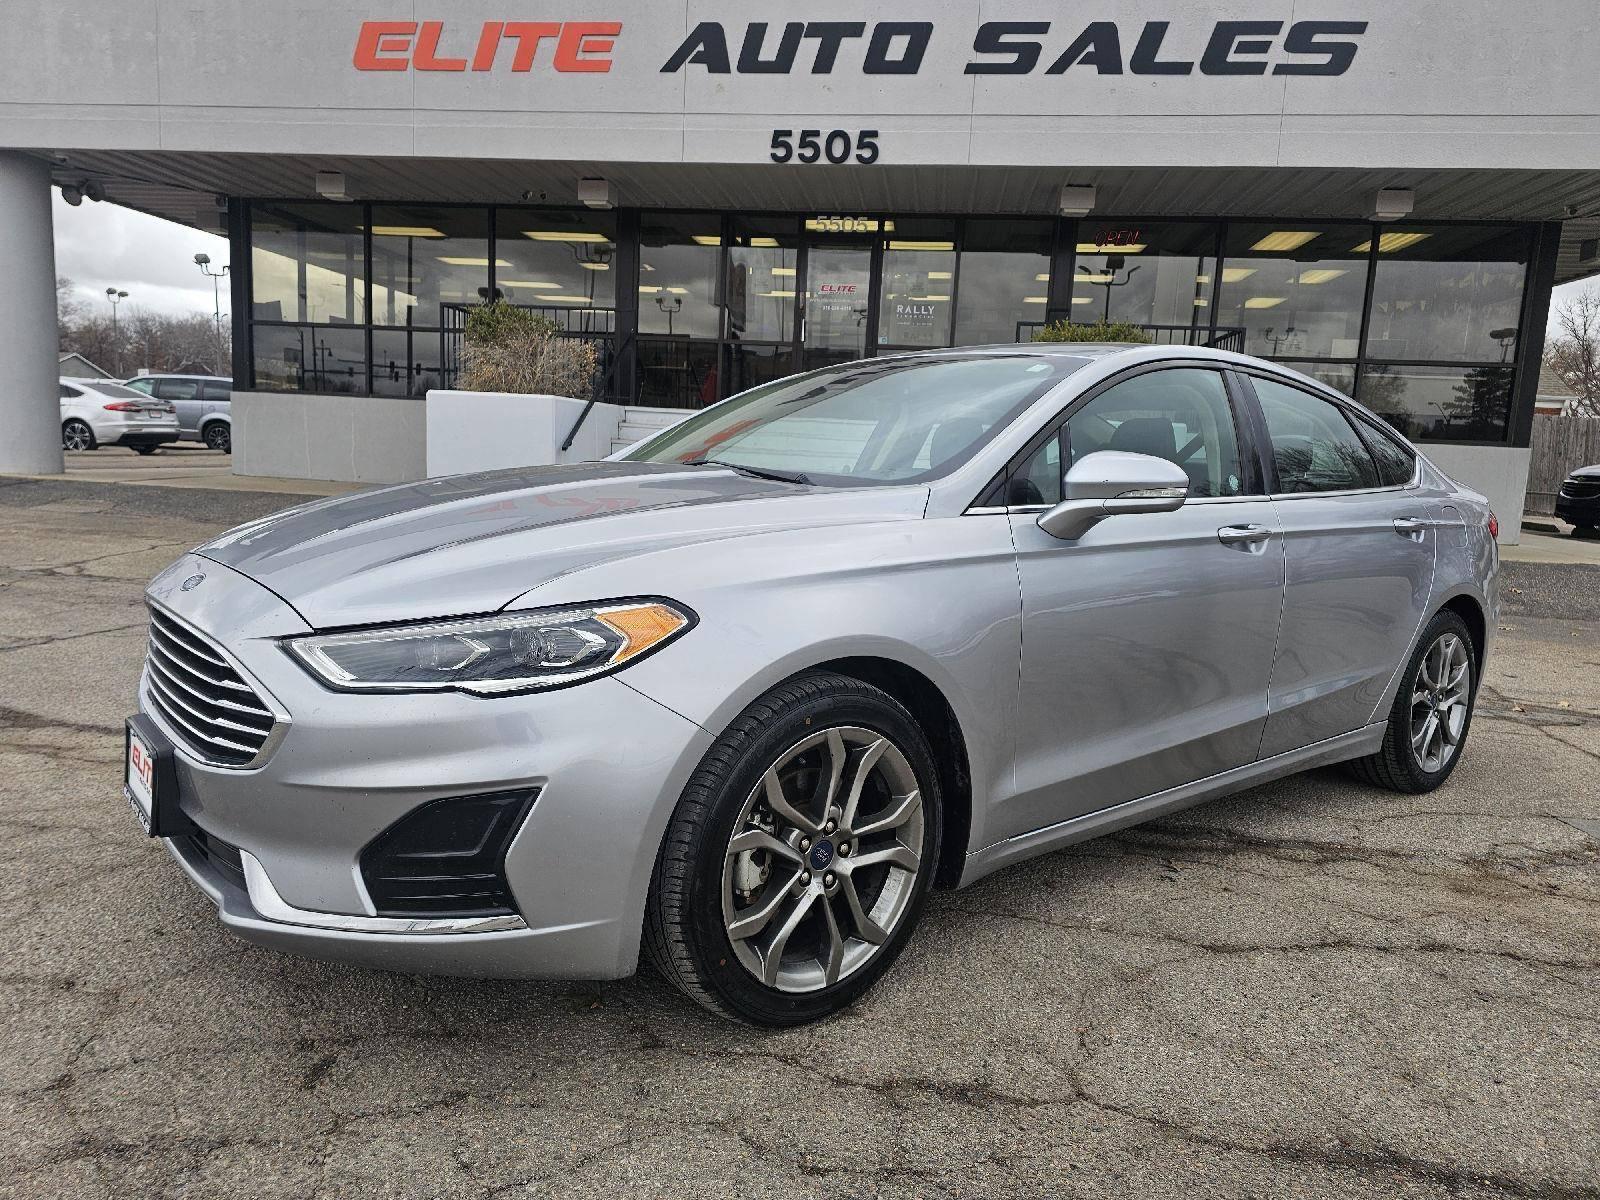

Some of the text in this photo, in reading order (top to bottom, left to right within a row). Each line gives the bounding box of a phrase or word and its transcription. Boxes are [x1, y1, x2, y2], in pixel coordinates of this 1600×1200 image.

[353, 20, 1369, 76] ELITE AUTO SALES
[770, 129, 879, 165] 5505
[816, 215, 868, 232] 5505
[1096, 229, 1141, 247] OPEN
[820, 284, 857, 293] ELITE
[896, 304, 935, 315] RALLY
